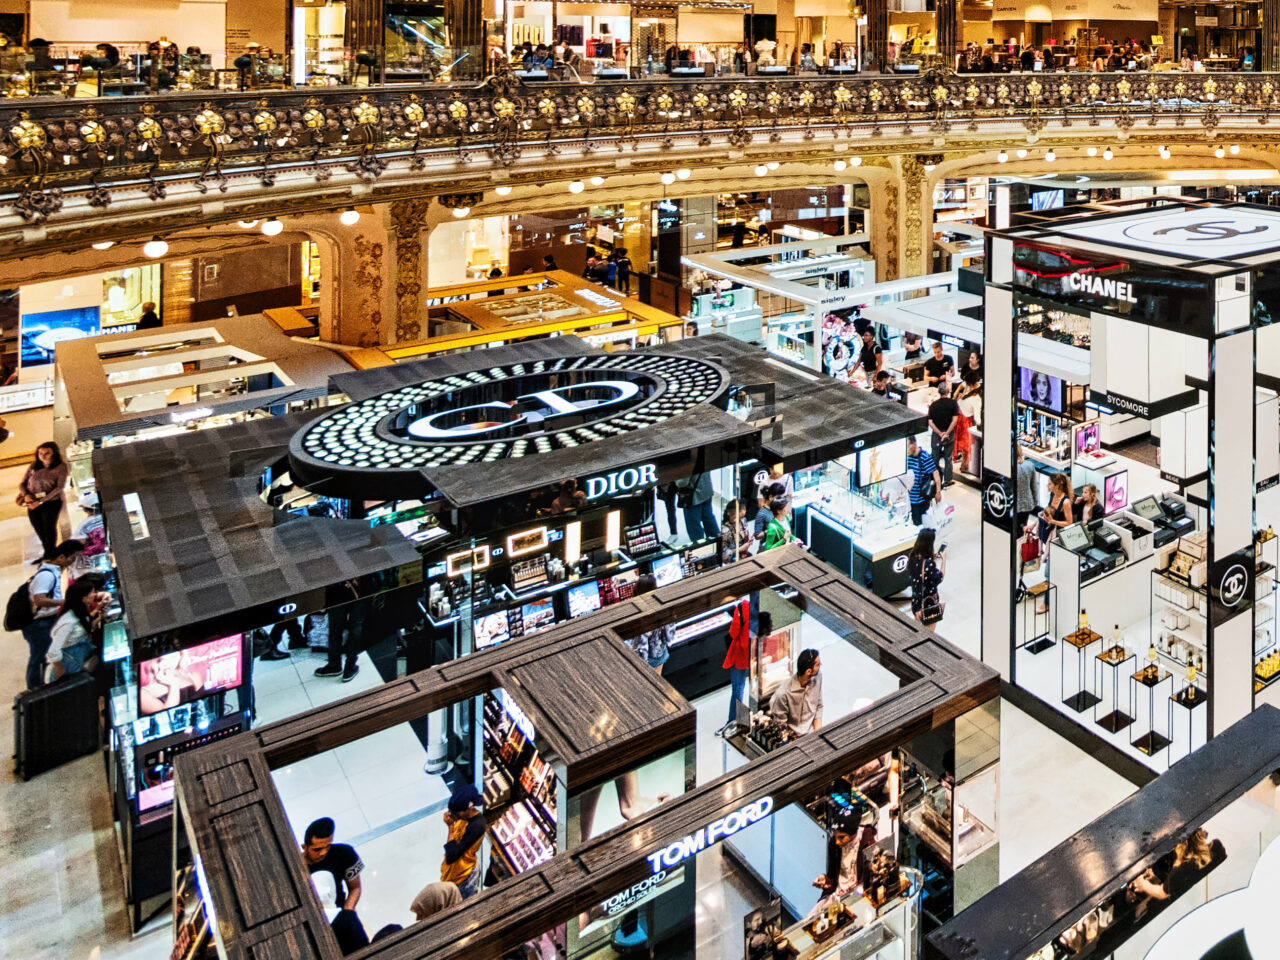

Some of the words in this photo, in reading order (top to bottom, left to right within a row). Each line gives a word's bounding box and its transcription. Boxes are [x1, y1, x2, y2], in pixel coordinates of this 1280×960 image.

[821, 295, 847, 305] sisley
[1069, 272, 1138, 304] CHANEL
[1106, 394, 1149, 416] SYCOMORE
[586, 463, 659, 501] DIOR
[647, 828, 705, 874] TOM
[706, 795, 775, 846] FORD
[600, 887, 630, 912] TOM
[629, 870, 667, 898] FORD
